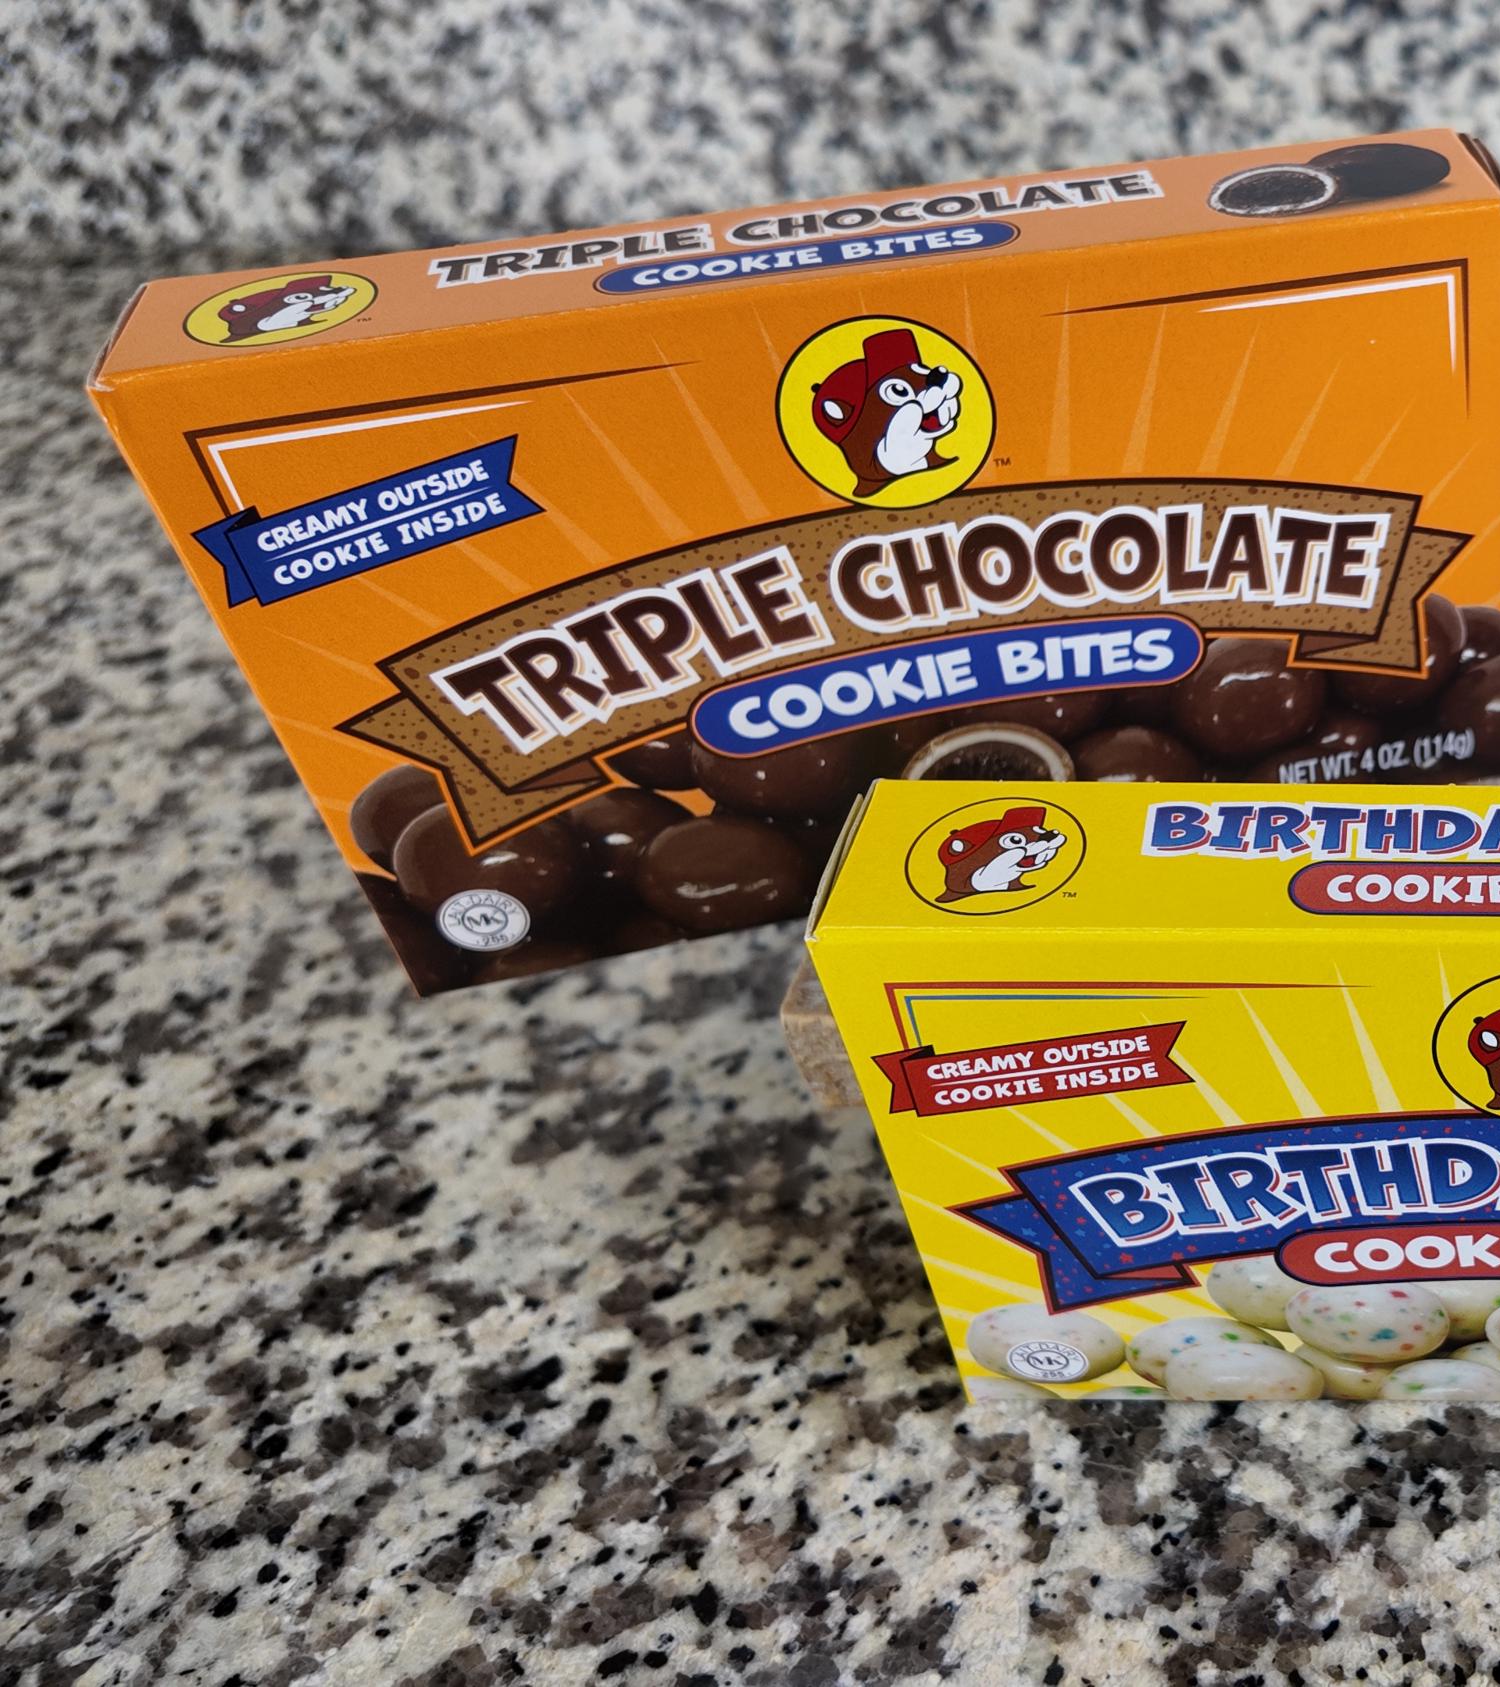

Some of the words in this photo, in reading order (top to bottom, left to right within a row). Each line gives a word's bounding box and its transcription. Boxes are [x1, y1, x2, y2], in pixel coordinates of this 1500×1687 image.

[432, 226, 710, 286] TRIPLE
[734, 173, 1162, 244] CHOCOLATE
[633, 248, 822, 287] COOKIE
[843, 229, 982, 261] BITES
[257, 499, 368, 553] CREAMY
[377, 459, 489, 513] OUTSIDE
[274, 530, 390, 586] COOKIE
[400, 492, 506, 546] INSIDE
[437, 551, 831, 748] TRIPLE
[833, 508, 1386, 628] CHOCOLATE
[729, 650, 978, 738] COOKIE
[998, 629, 1175, 685] BITES
[1279, 758, 1317, 784] NET
[1360, 748, 1375, 772] 4
[1414, 728, 1475, 768] (114g)
[927, 1051, 1034, 1080] CREAMY
[1044, 1035, 1151, 1063] OUTSIDE
[934, 1077, 1043, 1106] COOKIE
[1056, 1062, 1159, 1091] INSIDE
